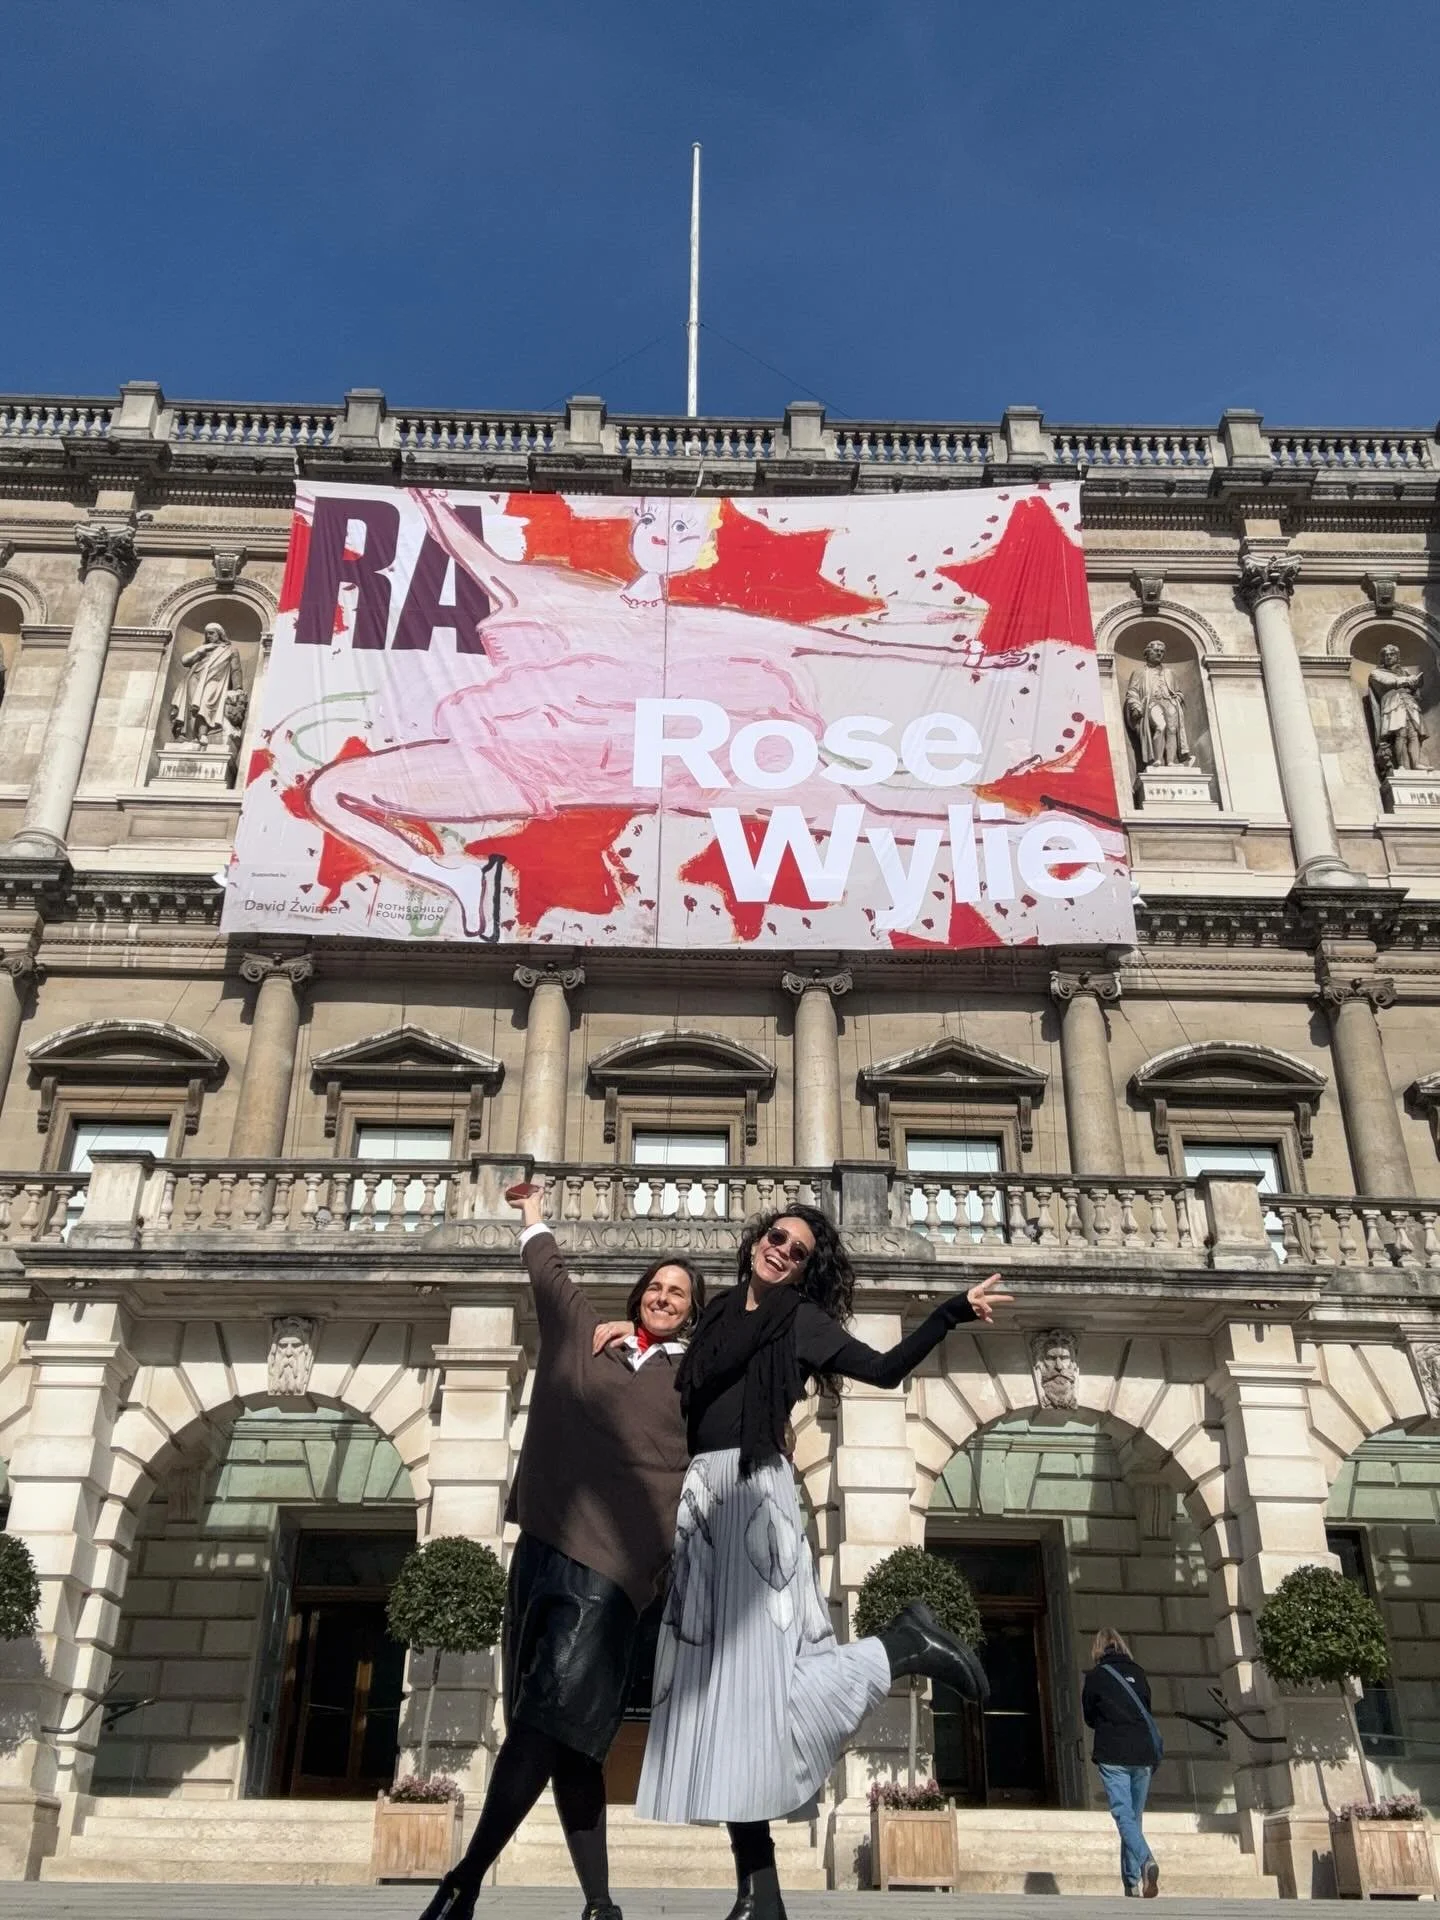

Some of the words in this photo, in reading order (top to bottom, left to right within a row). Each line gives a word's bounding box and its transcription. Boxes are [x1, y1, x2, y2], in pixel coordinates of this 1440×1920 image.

[294, 496, 490, 655] RA
[632, 698, 983, 790] Rose
[709, 801, 1106, 930] Wylie
[244, 900, 286, 912] David
[376, 910, 444, 921] FOUNDATION
[377, 902, 444, 913] ROTHSCHILD
[454, 1224, 568, 1247] ROY
[578, 1226, 744, 1249] ACADEMY
[838, 1230, 906, 1252] RTS.
